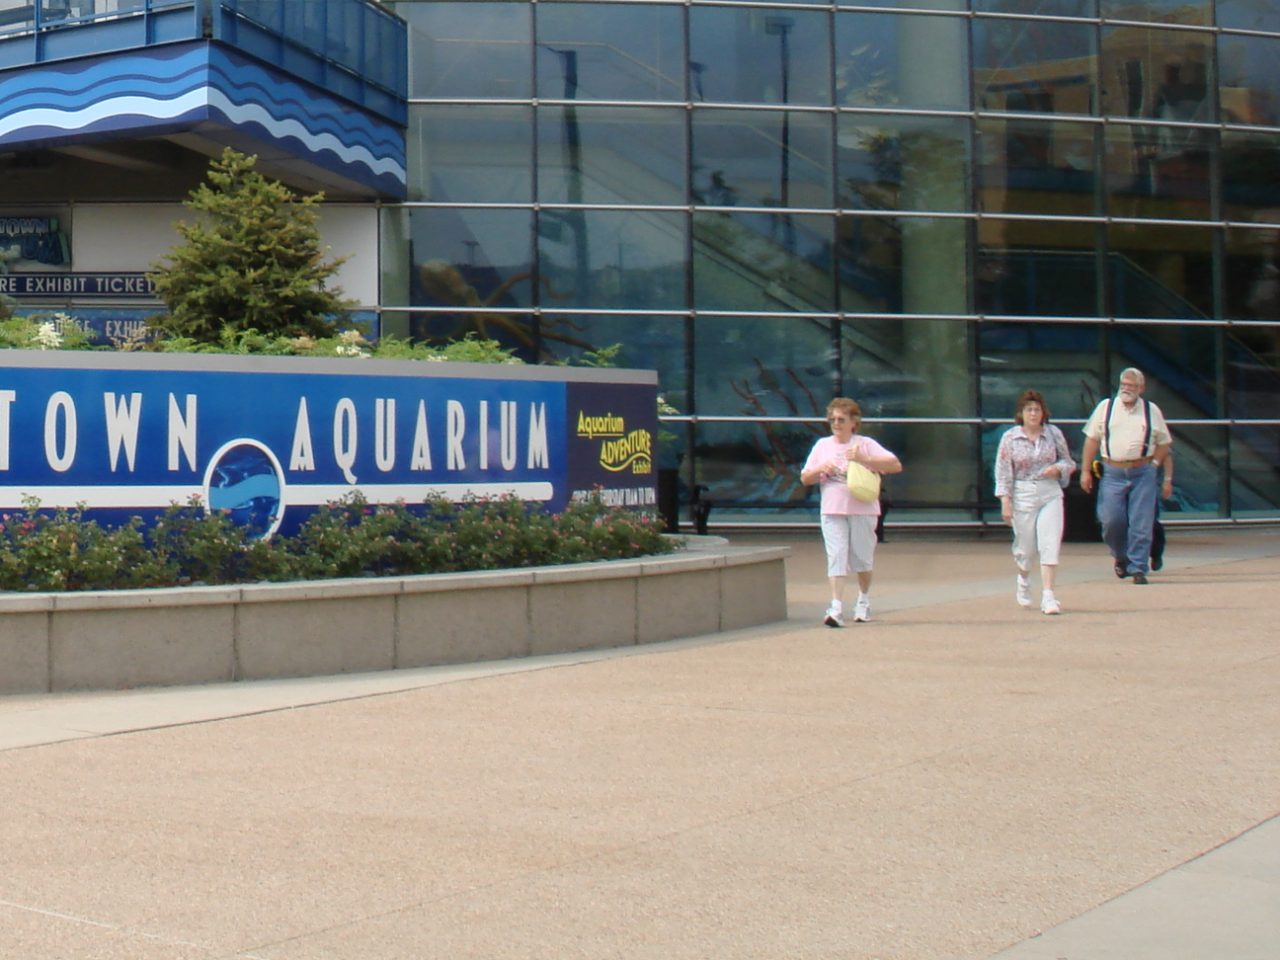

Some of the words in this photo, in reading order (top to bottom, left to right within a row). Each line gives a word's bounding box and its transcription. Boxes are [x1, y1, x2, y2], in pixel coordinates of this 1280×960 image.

[26, 277, 86, 293] EXHIBIT
[289, 395, 550, 485] AQUARIUM
[577, 410, 624, 439] Aquarium
[601, 429, 651, 464] ADVENTURE
